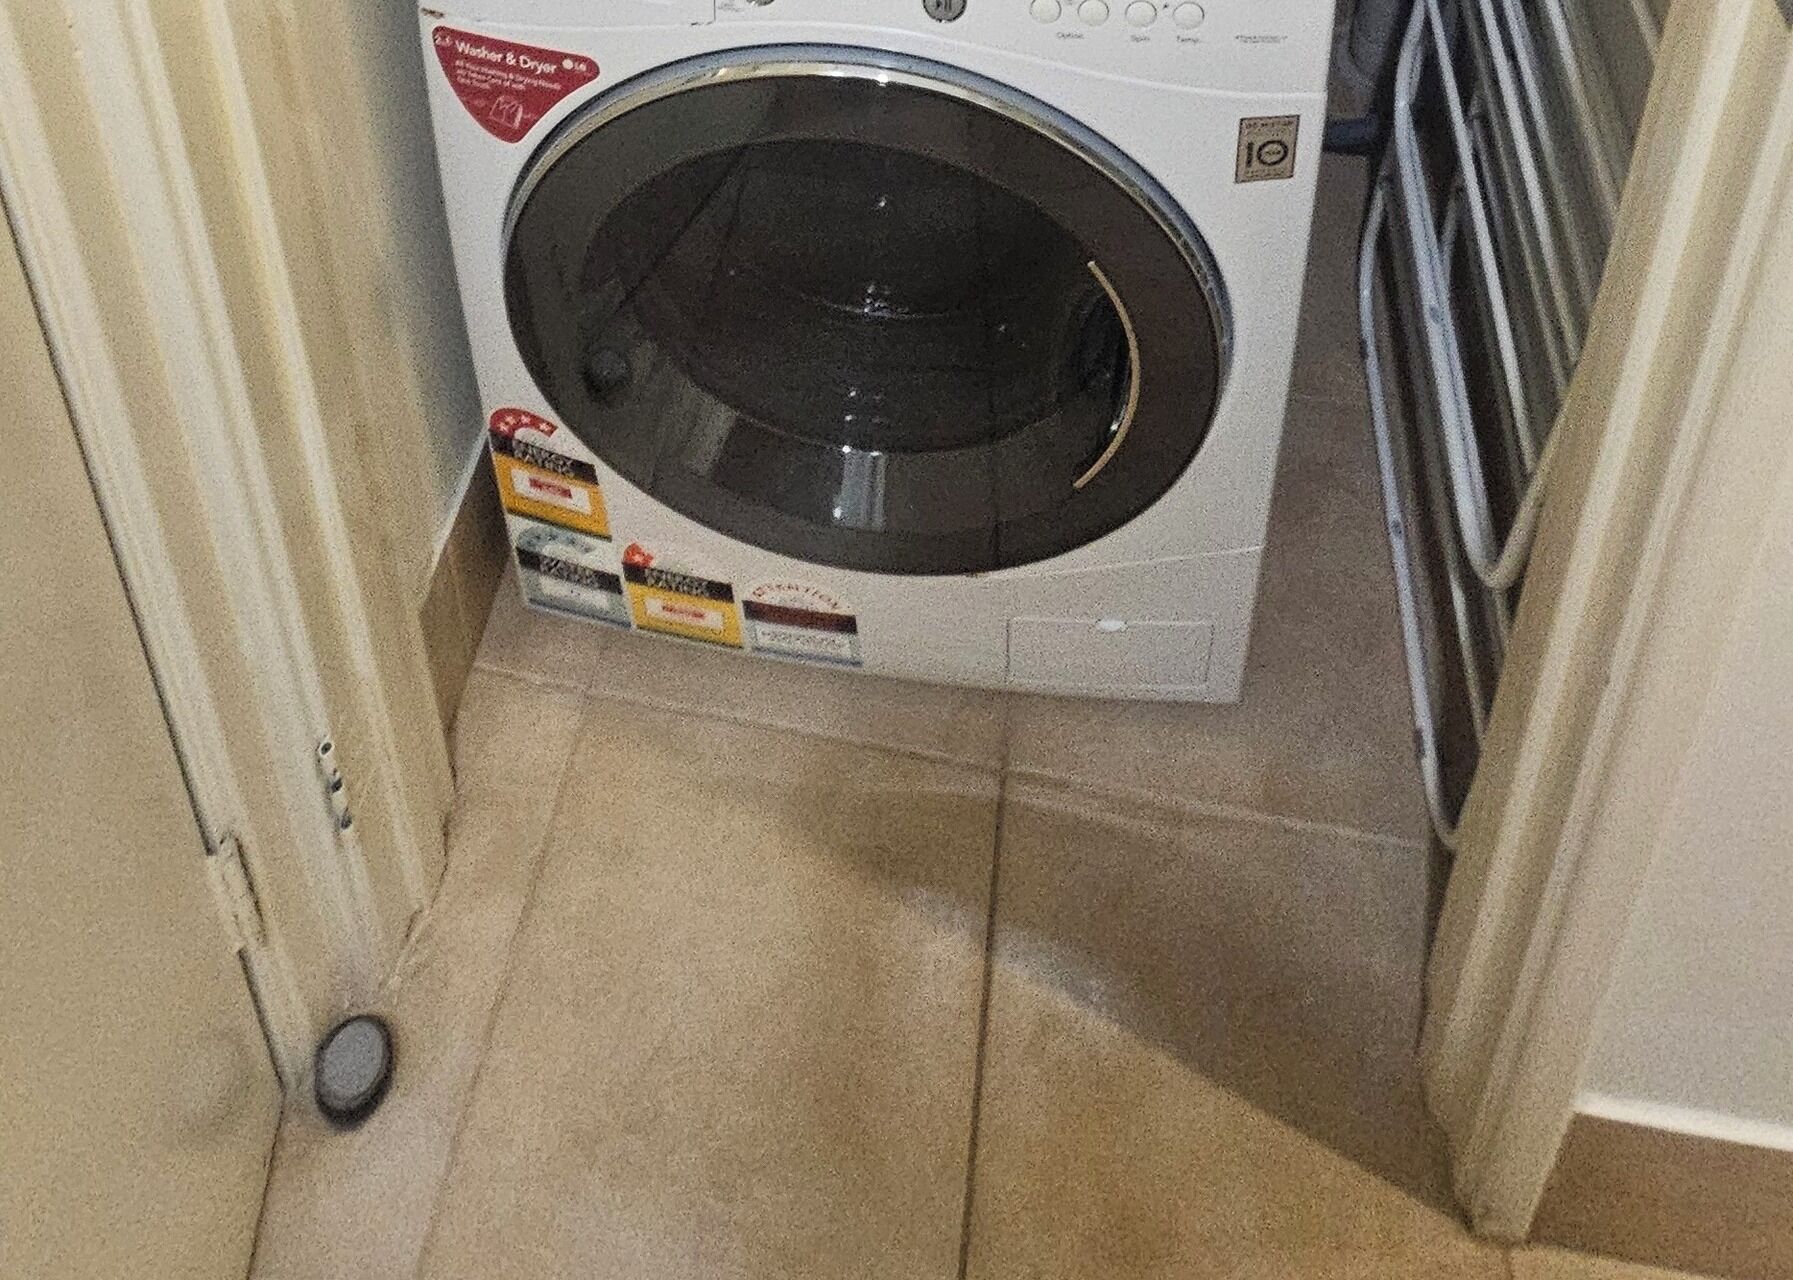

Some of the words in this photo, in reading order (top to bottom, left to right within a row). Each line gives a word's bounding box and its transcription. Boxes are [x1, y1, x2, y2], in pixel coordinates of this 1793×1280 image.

[454, 40, 504, 63] Washer
[505, 50, 517, 66] &
[519, 54, 558, 75] Dryer
